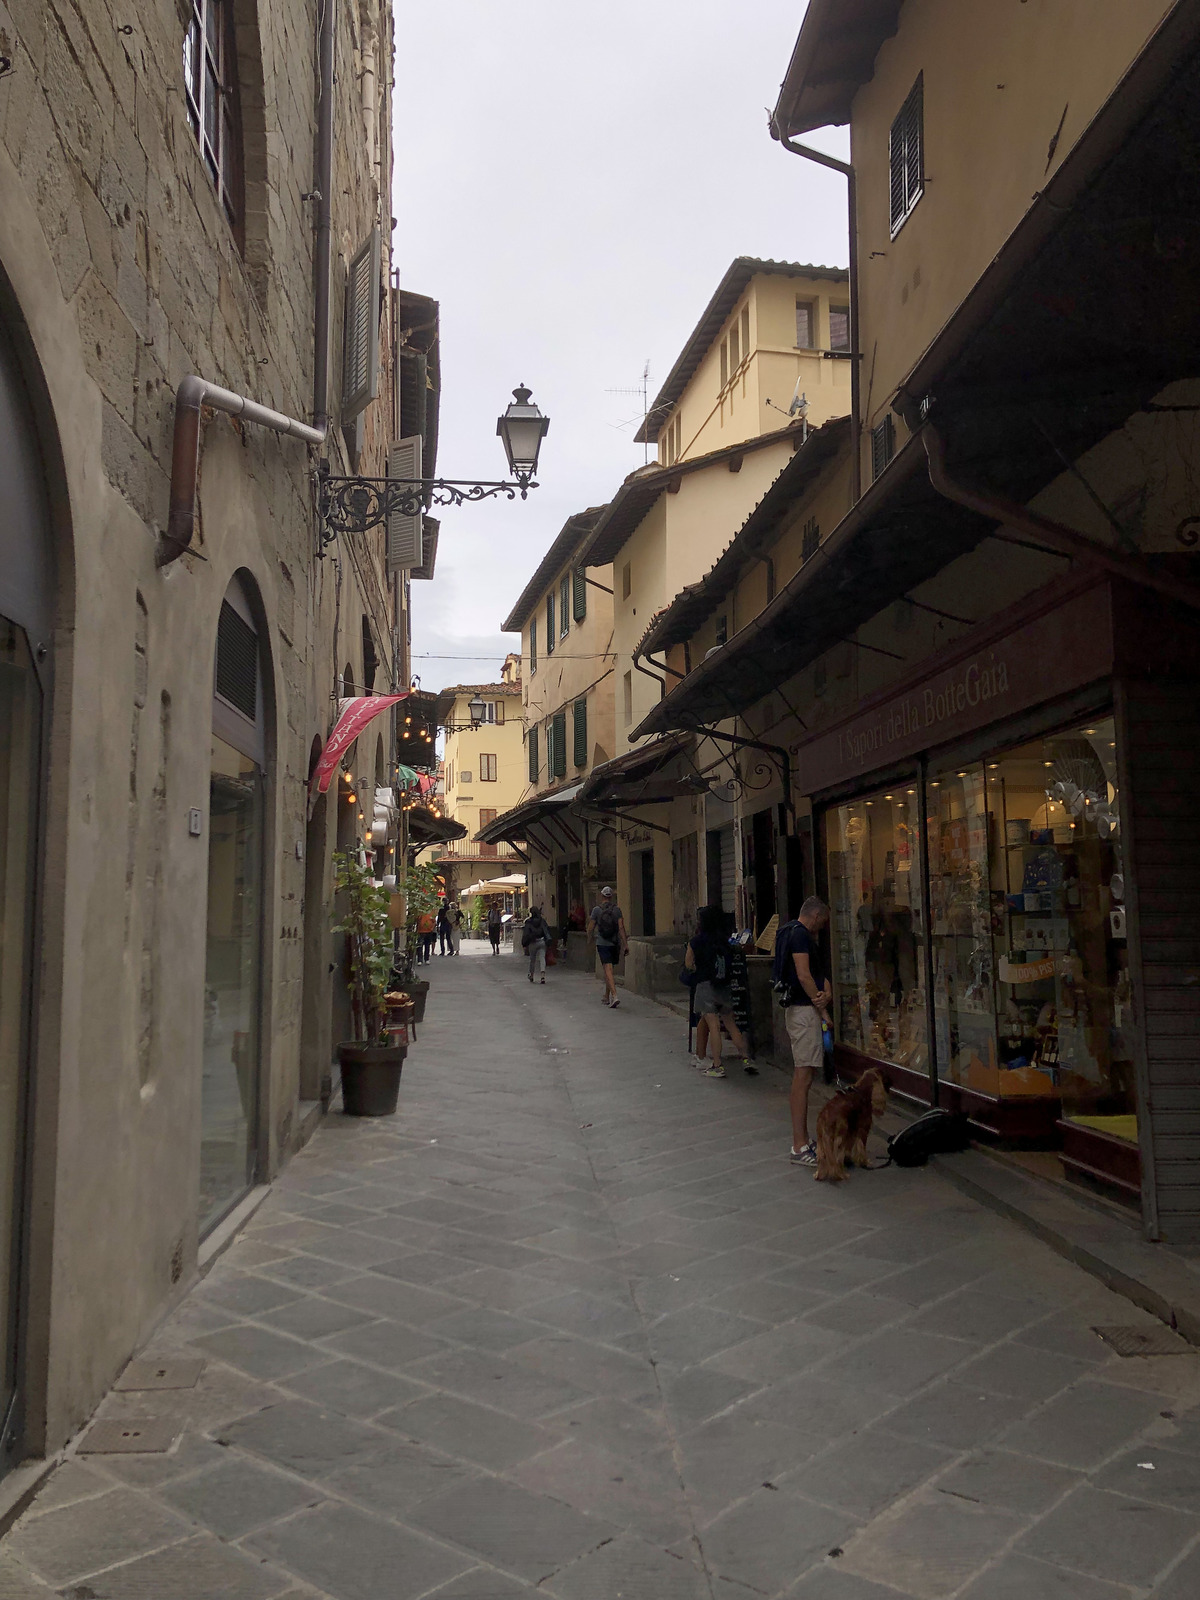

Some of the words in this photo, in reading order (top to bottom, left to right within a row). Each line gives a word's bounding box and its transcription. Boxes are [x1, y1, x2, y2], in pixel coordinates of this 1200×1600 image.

[838, 733, 844, 764] I
[846, 715, 884, 765] Sapori
[887, 699, 920, 744] della
[923, 653, 1010, 727] BotteGaia
